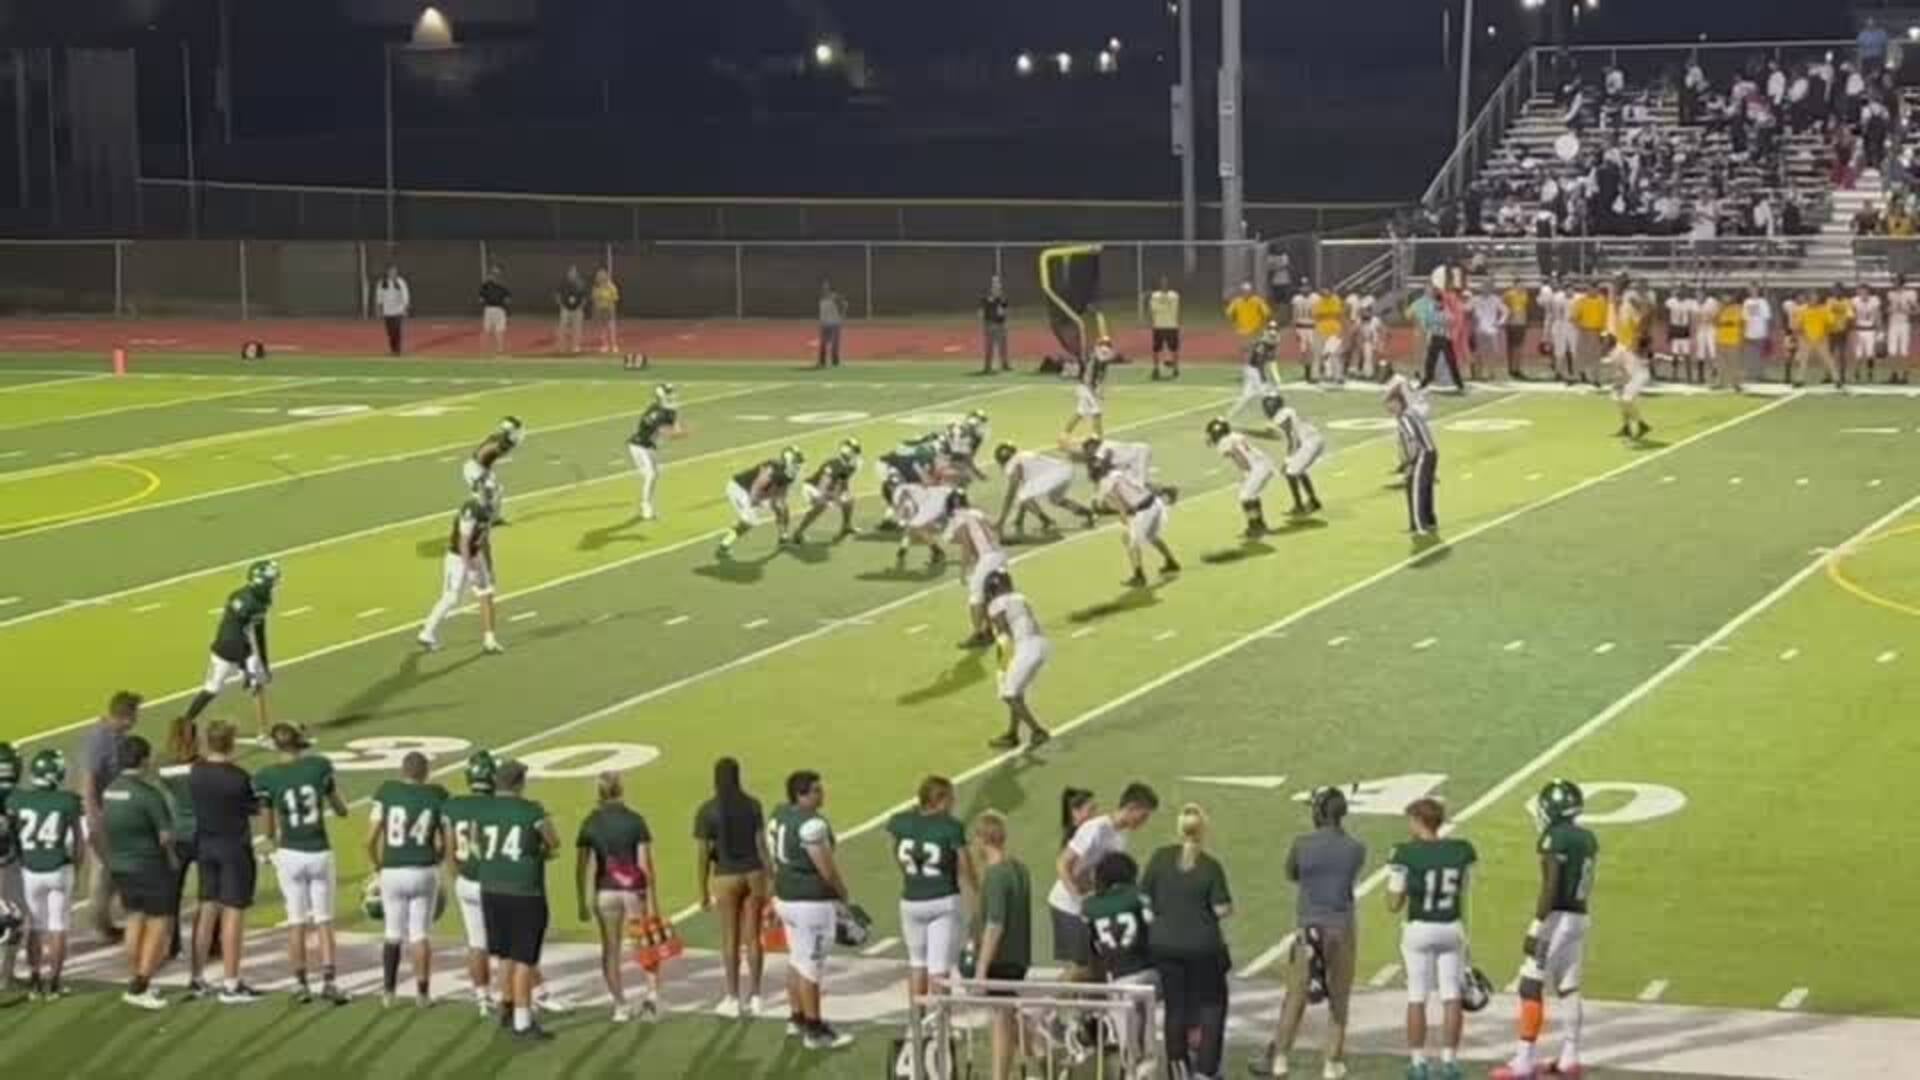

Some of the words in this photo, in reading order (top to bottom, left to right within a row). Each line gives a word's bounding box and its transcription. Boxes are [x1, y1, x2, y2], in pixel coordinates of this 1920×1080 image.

[283, 785, 320, 828] 13
[387, 805, 432, 846] 84
[19, 809, 60, 851] 24
[482, 825, 522, 861] 74
[898, 838, 941, 877] 52
[1423, 867, 1459, 911] 15
[1094, 912, 1137, 948] 57
